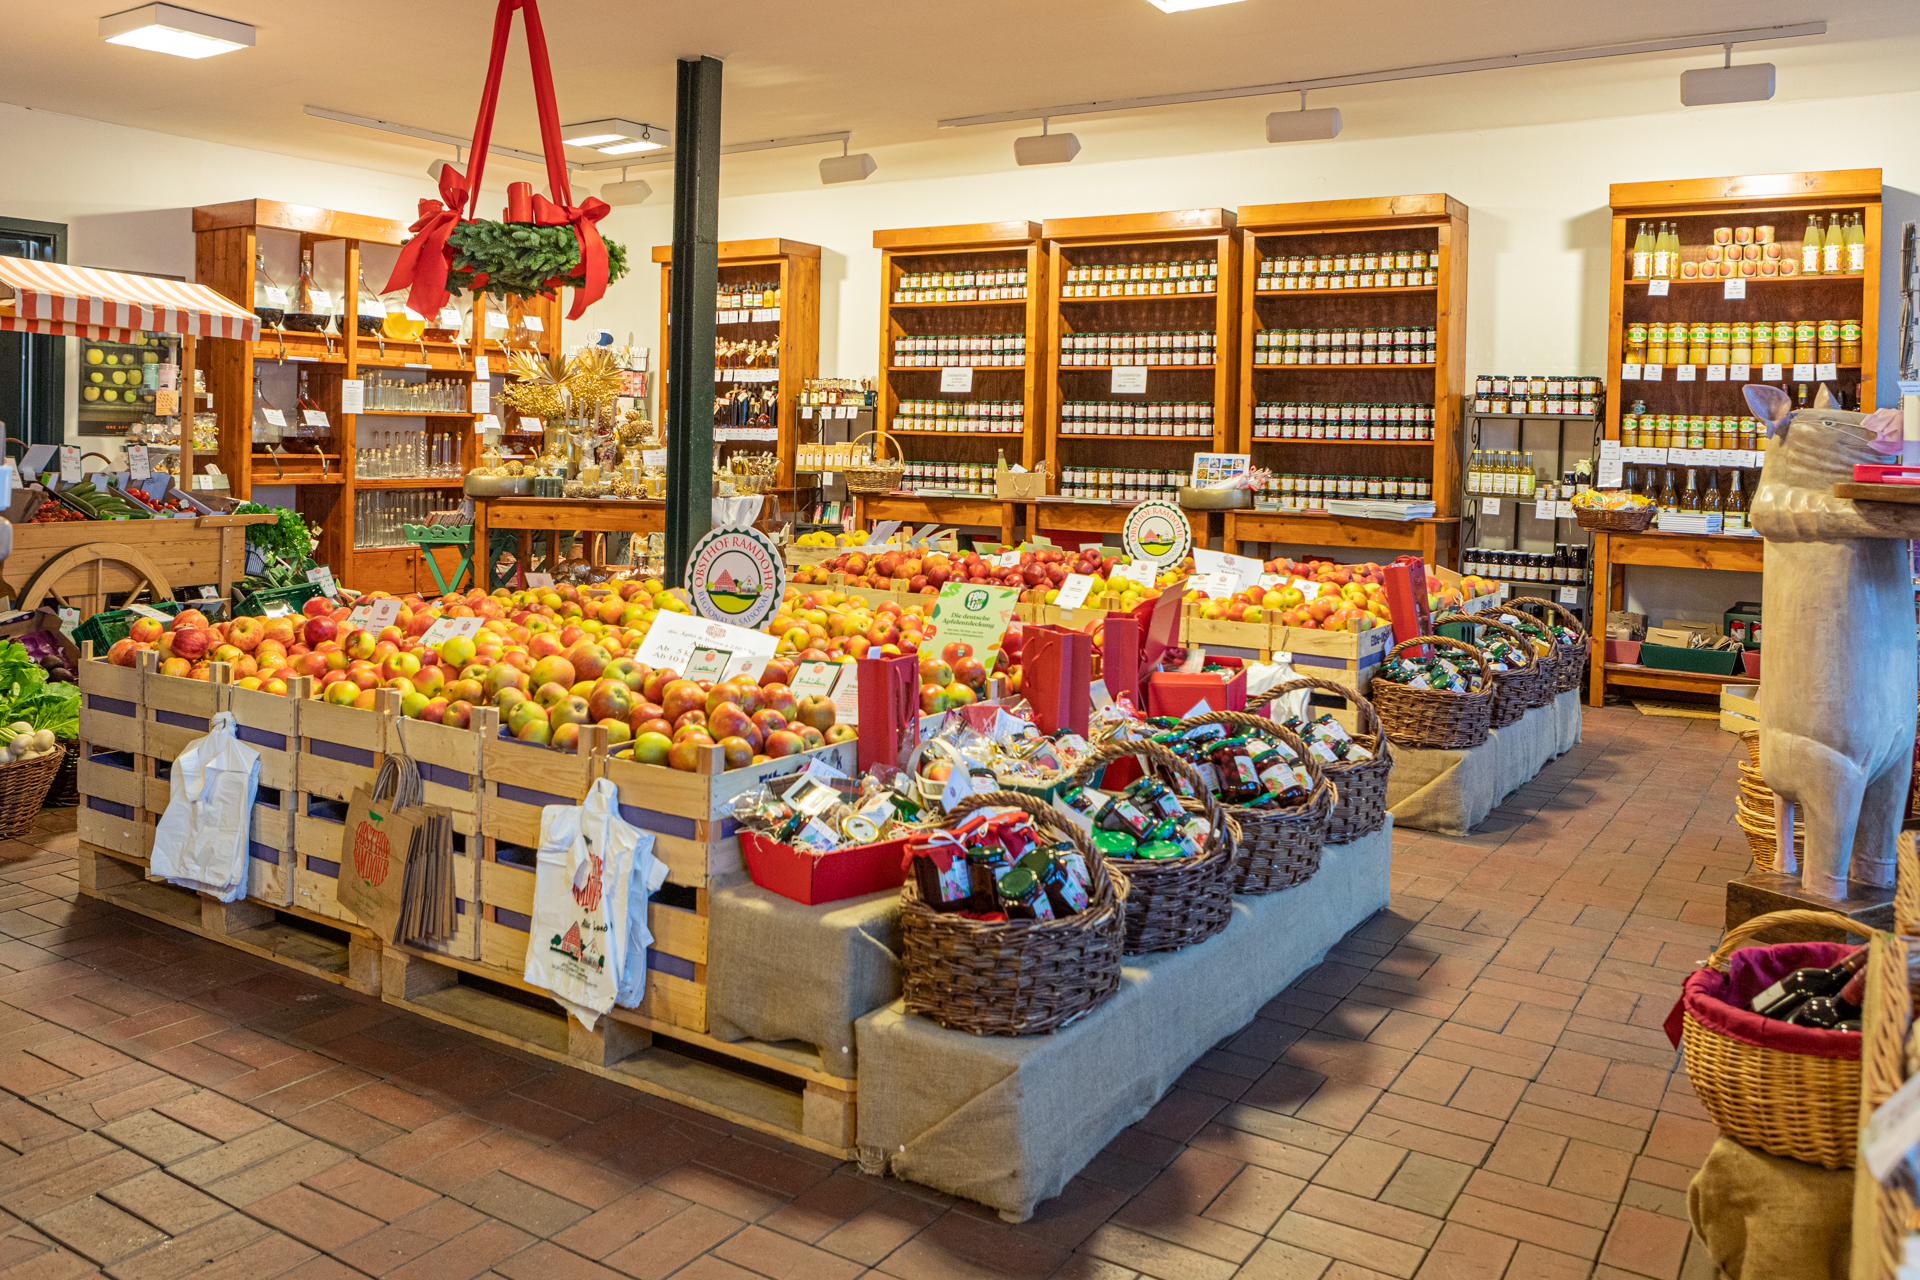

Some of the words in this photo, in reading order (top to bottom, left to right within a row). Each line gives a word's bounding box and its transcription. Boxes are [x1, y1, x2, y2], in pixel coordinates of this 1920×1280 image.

[1130, 508, 1151, 542] OBSTHOF
[1152, 507, 1184, 539] RAMDOHR
[695, 537, 729, 588] OBSTHOF
[732, 536, 774, 591] RAMDOHR
[698, 591, 728, 623] REGIONAL
[738, 594, 770, 626] SAISONAL
[942, 618, 995, 629] Apfelentdeckung
[962, 613, 990, 621] deutsche
[652, 652, 666, 660] Ab
[669, 654, 679, 662] 10
[656, 644, 670, 652] Ab
[355, 821, 391, 859] OBSTHOF
[354, 840, 389, 887] RAMDOHR
